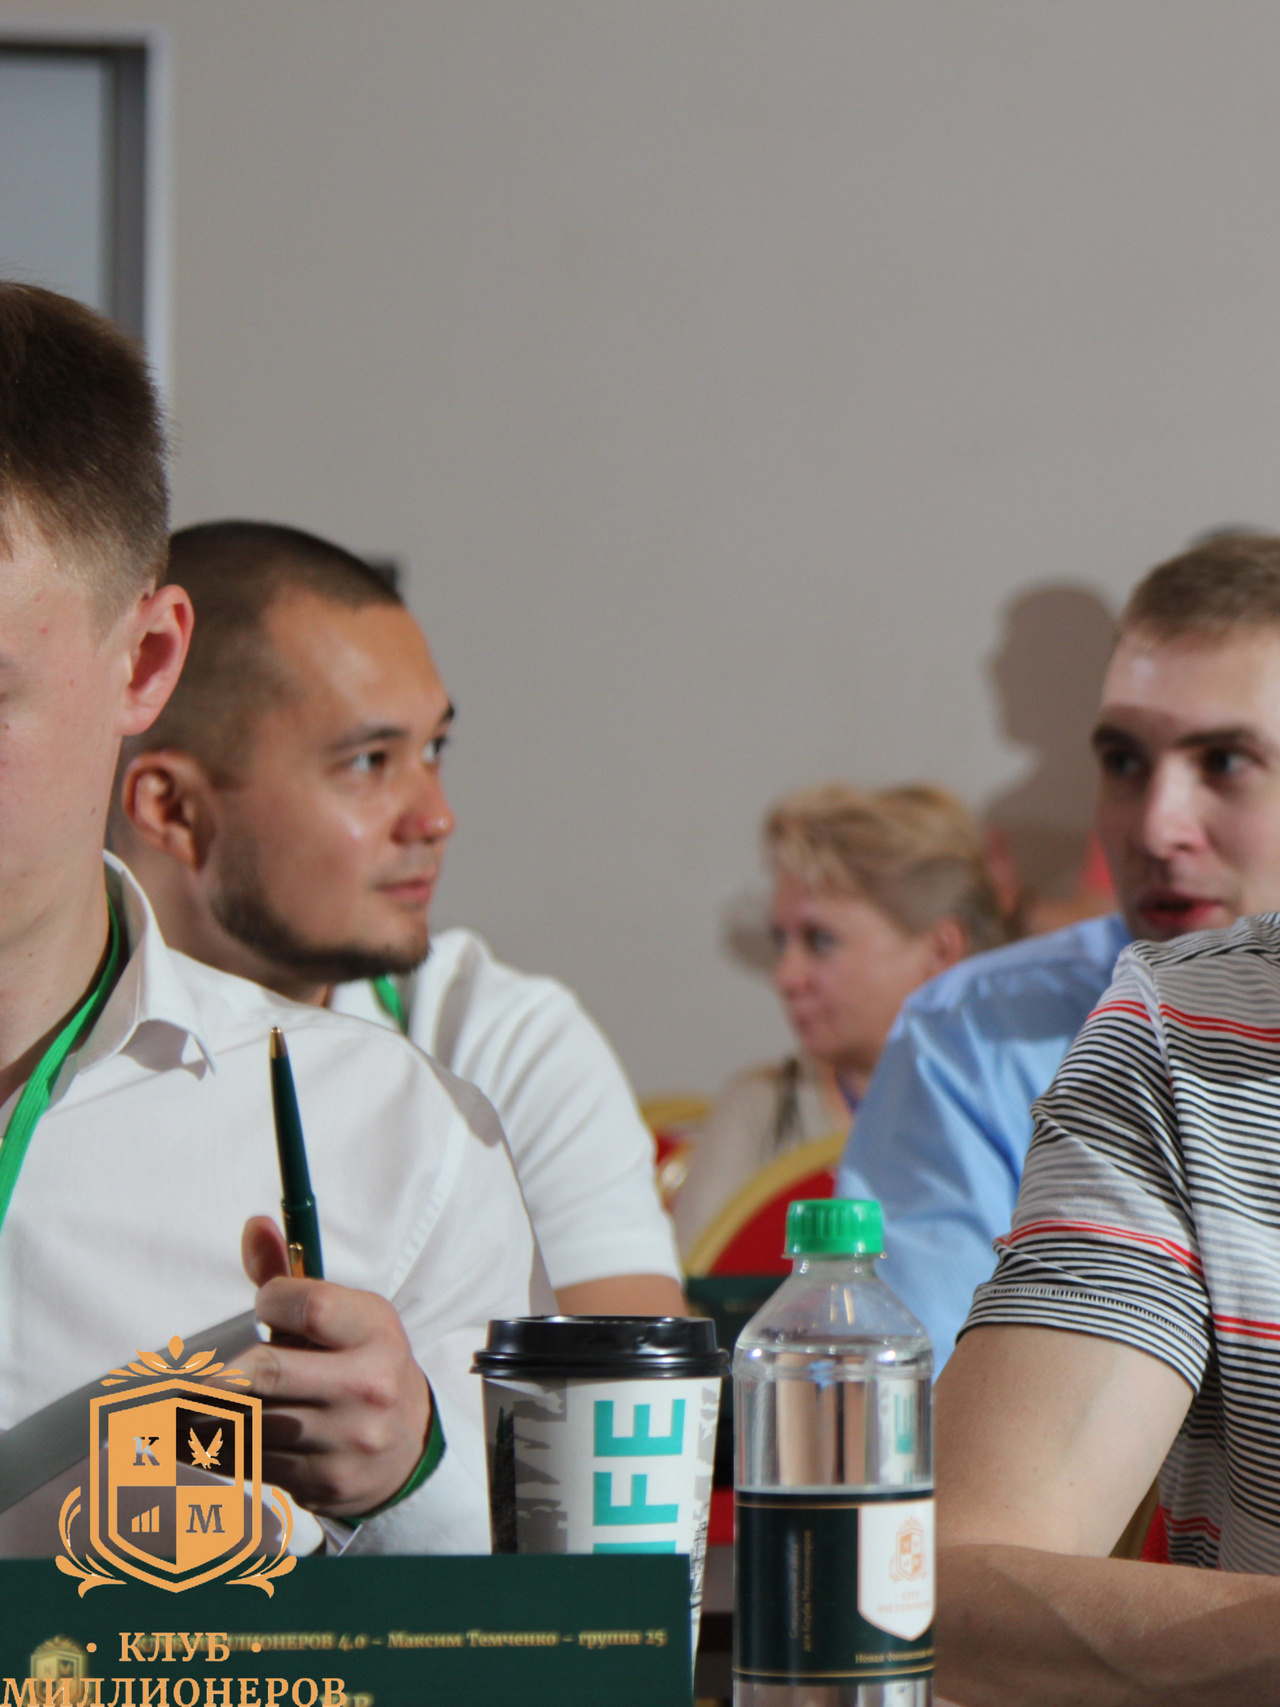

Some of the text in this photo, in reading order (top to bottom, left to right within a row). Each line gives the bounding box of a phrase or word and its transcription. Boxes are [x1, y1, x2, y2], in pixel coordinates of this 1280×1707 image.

[339, 1632, 369, 1653] 4.0
[387, 1630, 465, 1649] Максим
[468, 1629, 561, 1649] Темченко
[578, 1630, 641, 1650] группа
[644, 1629, 668, 1650] 25
